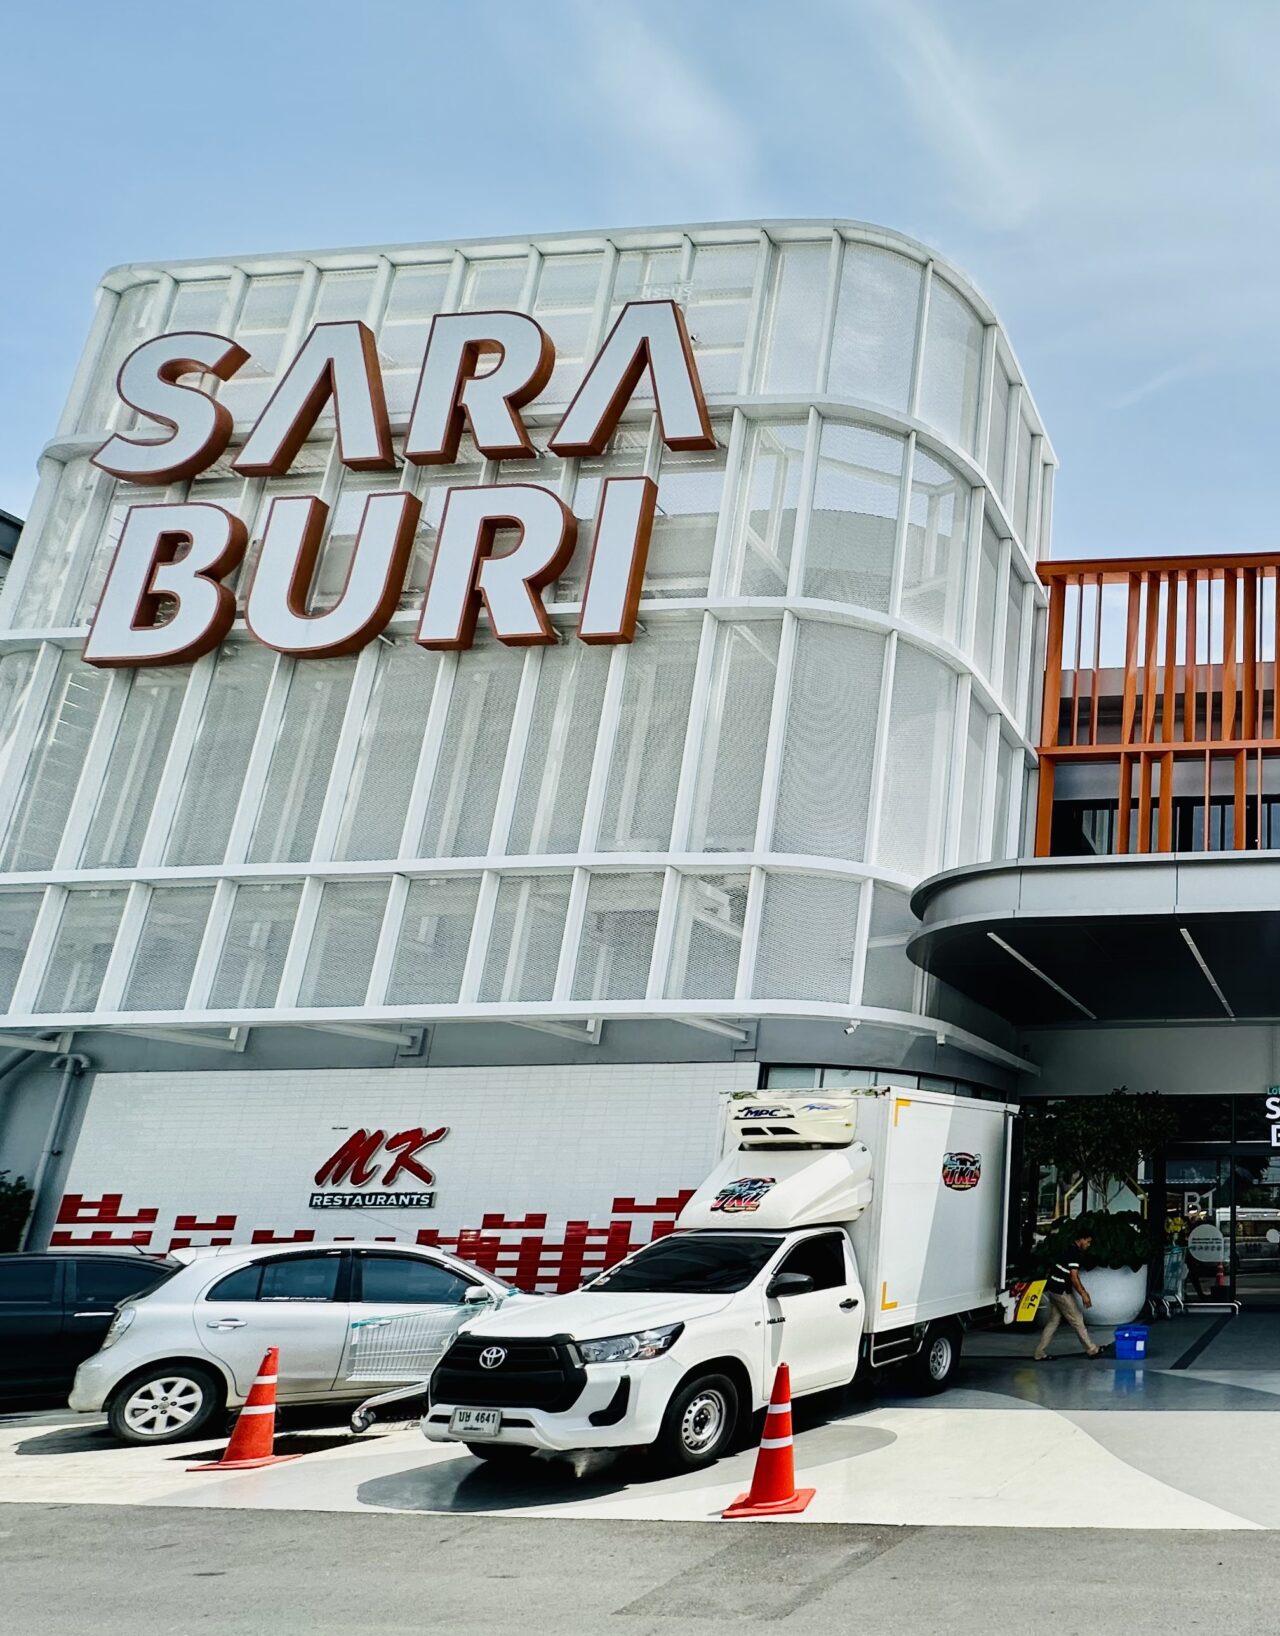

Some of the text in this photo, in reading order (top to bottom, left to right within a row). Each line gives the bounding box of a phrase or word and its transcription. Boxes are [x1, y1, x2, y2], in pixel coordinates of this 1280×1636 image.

[91, 298, 717, 485] SARA
[82, 476, 658, 669] BURI
[743, 1109, 781, 1117] MPC
[314, 1127, 451, 1188] MK
[312, 1194, 430, 1207] RESTAURANTS
[475, 1412, 496, 1423] 4641
